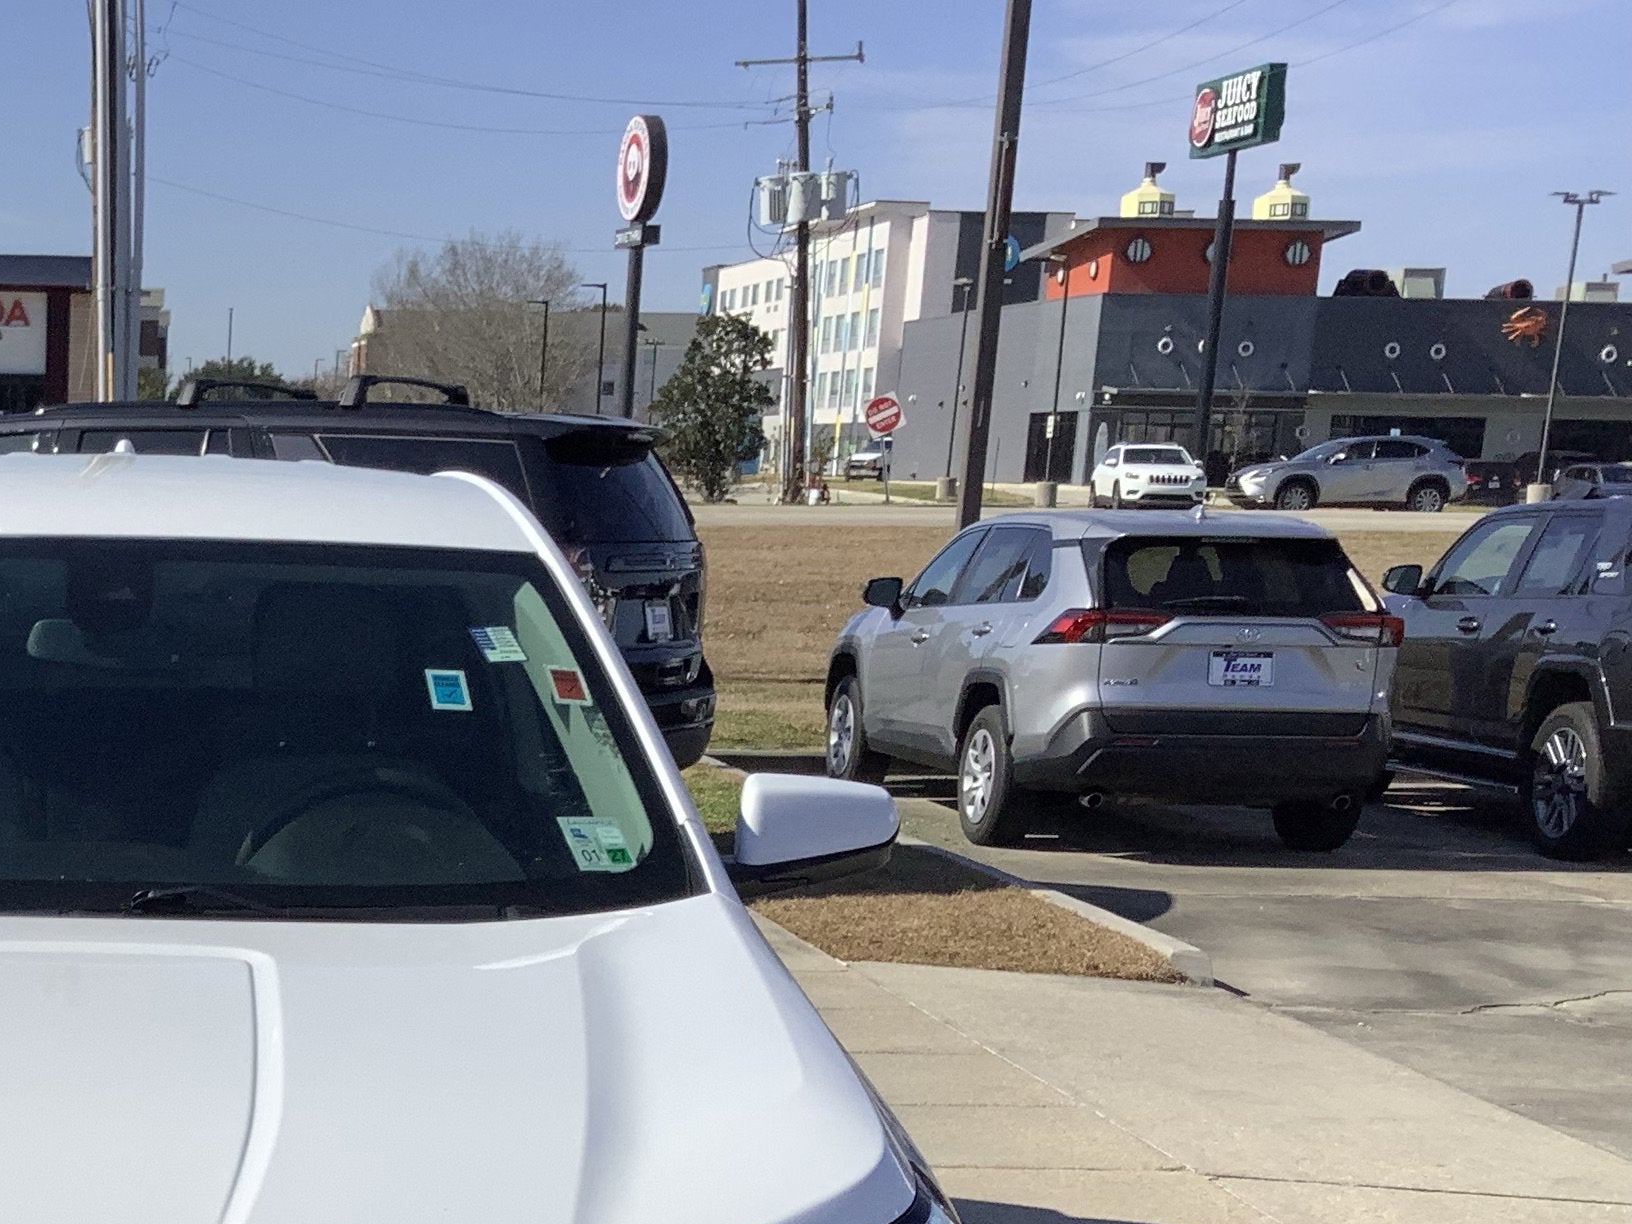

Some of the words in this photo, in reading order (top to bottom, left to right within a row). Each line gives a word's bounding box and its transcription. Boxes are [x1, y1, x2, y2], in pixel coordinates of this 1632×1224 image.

[1217, 70, 1261, 108] JUICY
[1215, 101, 1257, 129] SEAFOOD
[581, 849, 601, 862] 01
